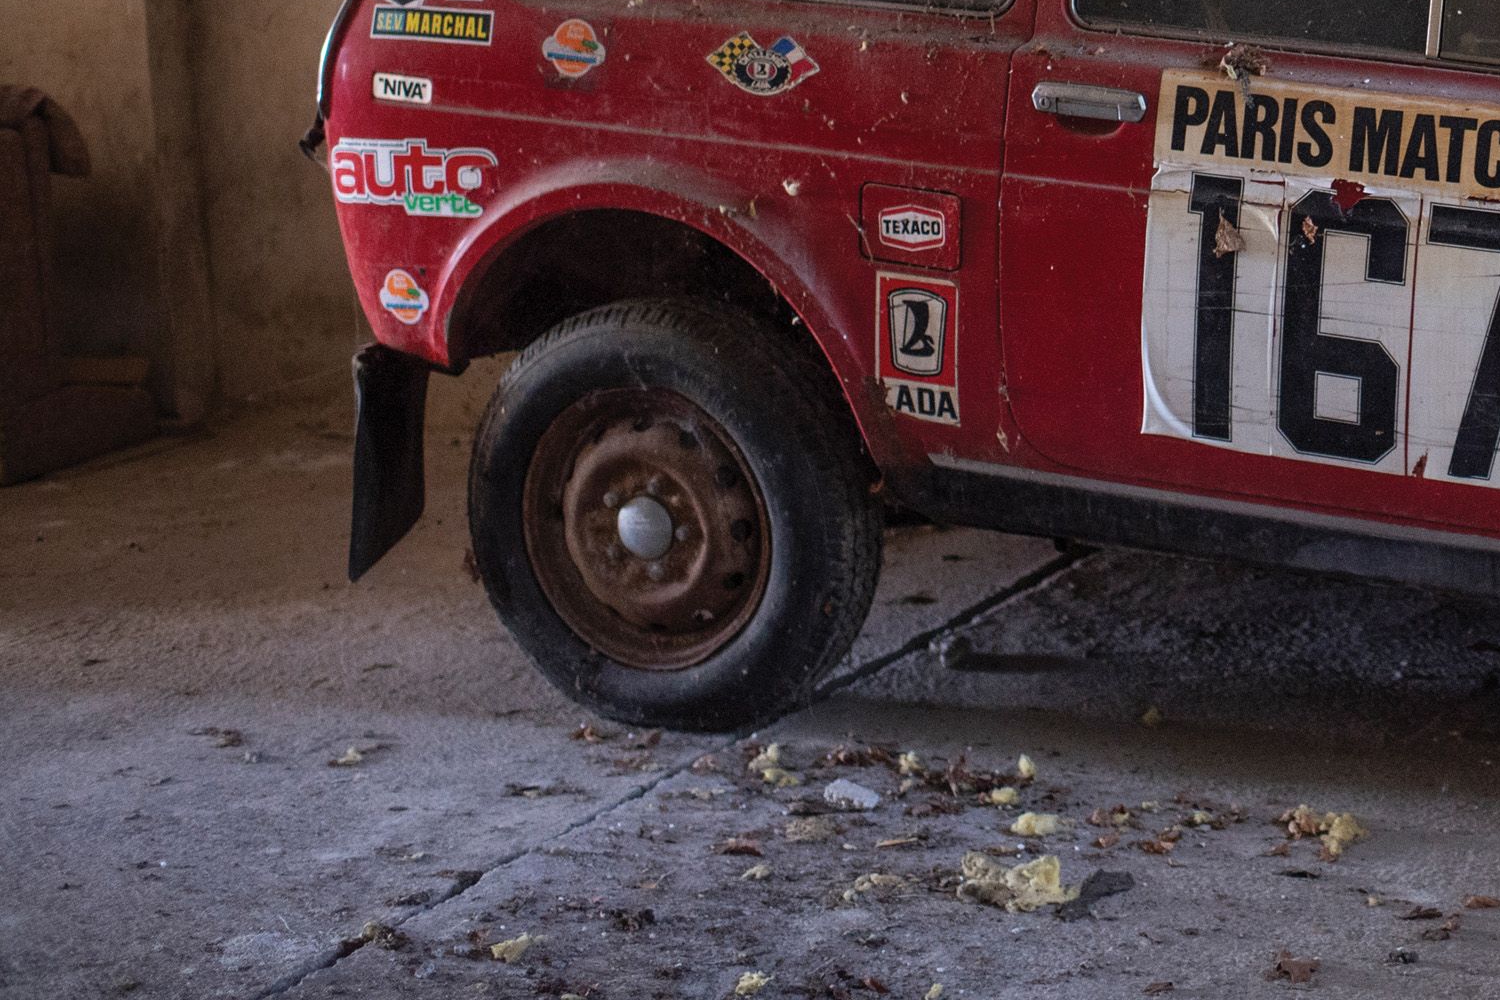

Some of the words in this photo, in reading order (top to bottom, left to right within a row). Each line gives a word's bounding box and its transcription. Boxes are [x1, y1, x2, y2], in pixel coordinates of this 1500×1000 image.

[405, 11, 488, 39] MARCHAL
[1170, 84, 1337, 168] PARIS
[335, 145, 492, 197] auto
[404, 194, 480, 214] verte
[883, 218, 941, 236] TEXACO
[895, 384, 958, 420] ADA
